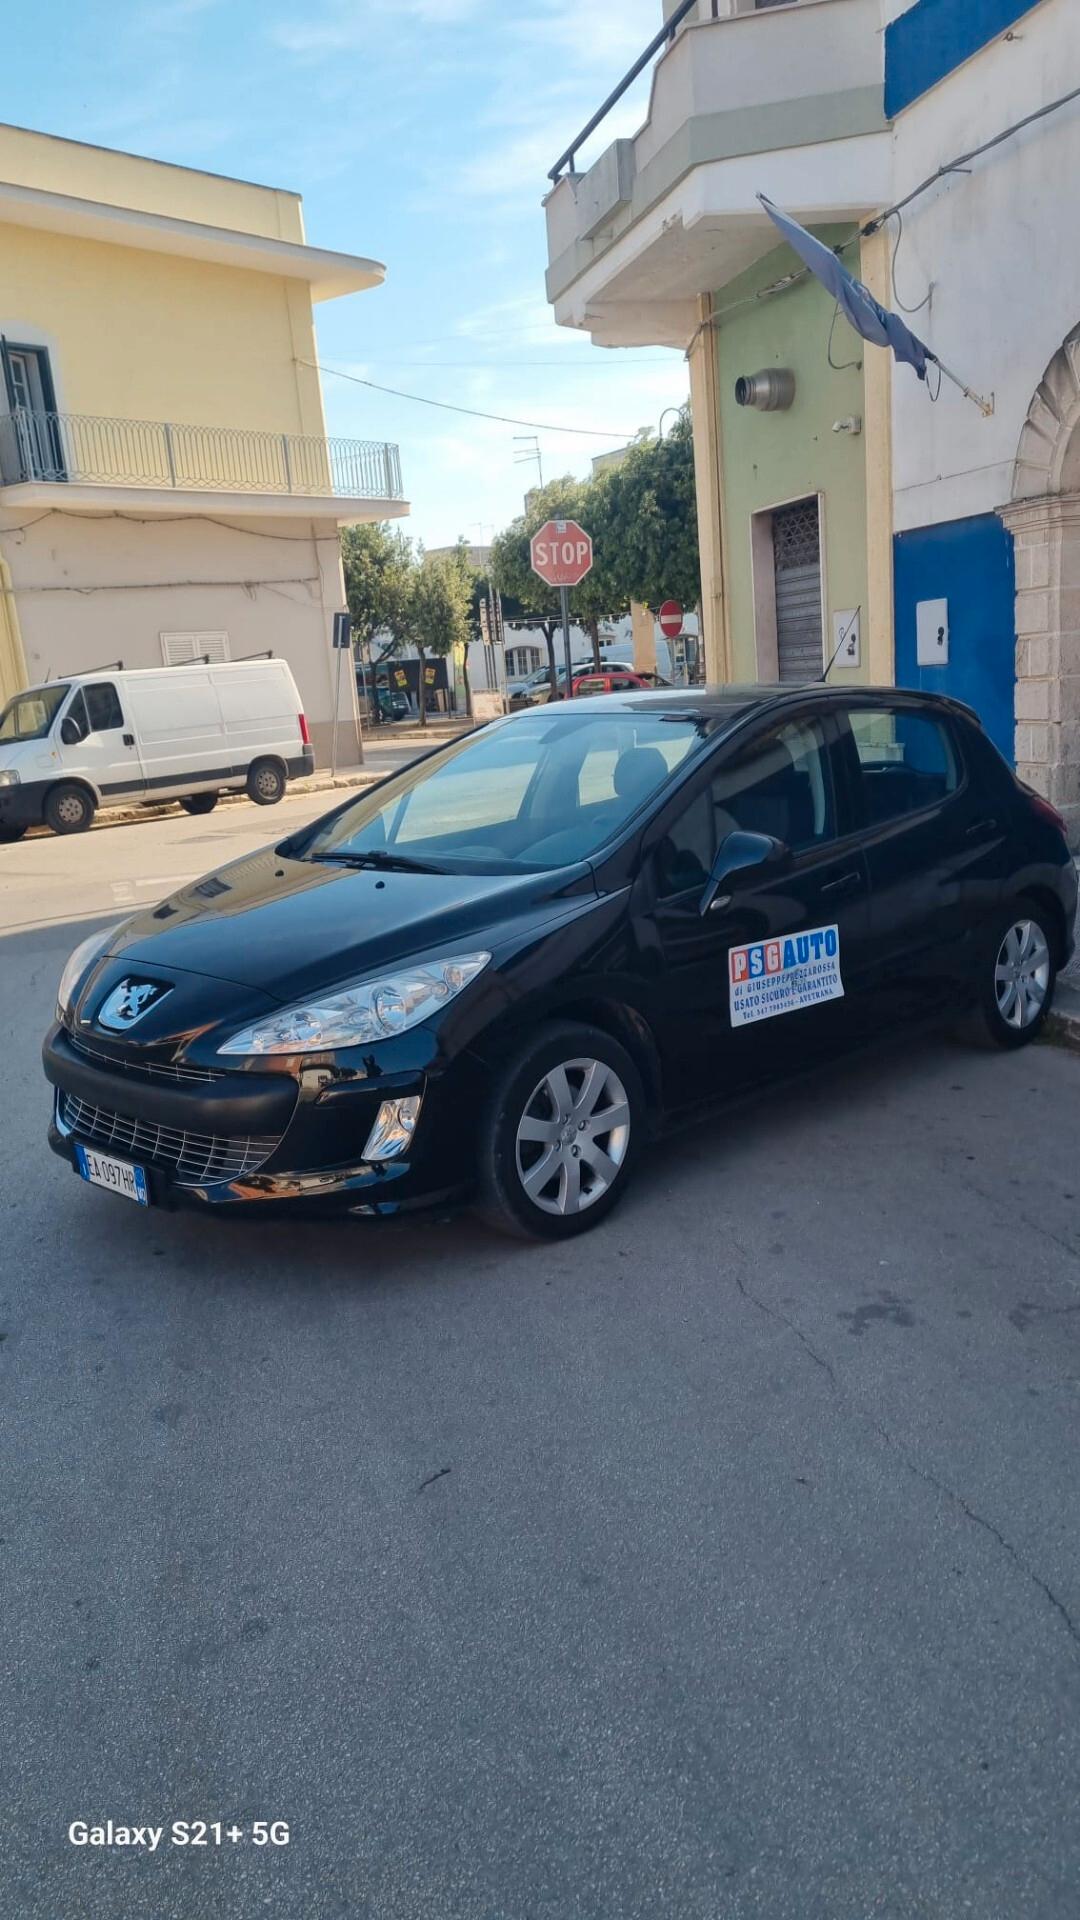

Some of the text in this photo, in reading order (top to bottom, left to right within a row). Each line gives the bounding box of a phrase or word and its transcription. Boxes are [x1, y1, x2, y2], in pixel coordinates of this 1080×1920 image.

[535, 541, 588, 566] STOP
[734, 995, 760, 1011] USATO
[761, 987, 790, 1005] SICURO
[798, 974, 838, 996] GARANTITO
[747, 974, 786, 993] GIUSEPPE
[799, 989, 834, 1004] AVETRANA
[86, 1154, 137, 1194] EA 097HR
